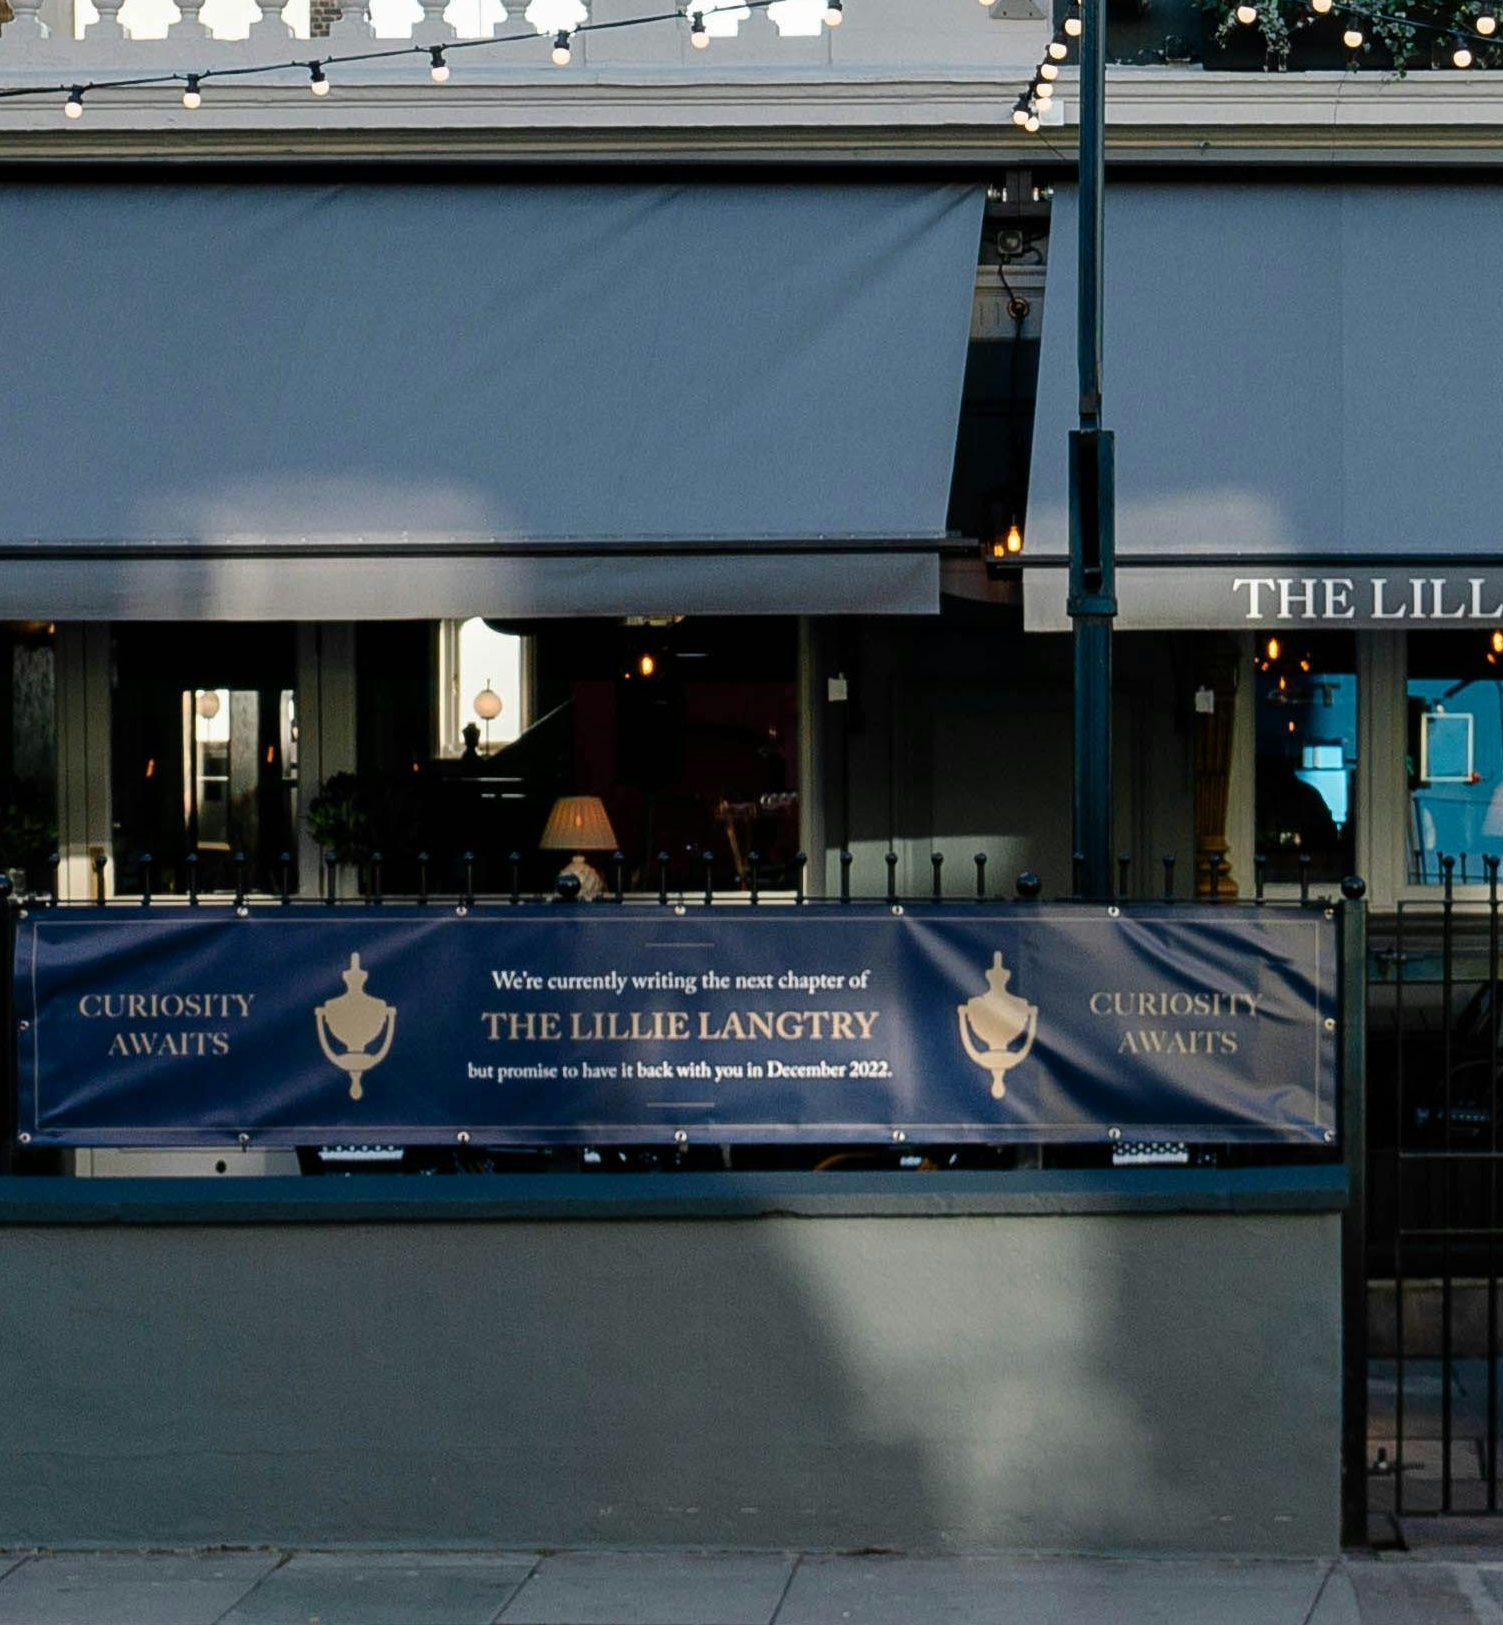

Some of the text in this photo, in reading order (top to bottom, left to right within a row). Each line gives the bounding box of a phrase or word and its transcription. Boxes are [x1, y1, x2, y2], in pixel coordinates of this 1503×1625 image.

[1233, 578, 1355, 619] THE
[491, 969, 871, 995] We're currently writing the next chapter of
[78, 993, 255, 1018] CURIOSITY
[1089, 991, 1263, 1016] CURIOSITY
[481, 1010, 879, 1040] THE LILLIE LANGTRY
[108, 1032, 230, 1056] AWAITS
[1118, 1029, 1238, 1054] AWAITS
[467, 1060, 893, 1084] but promise to have it back with you in December 2022.
